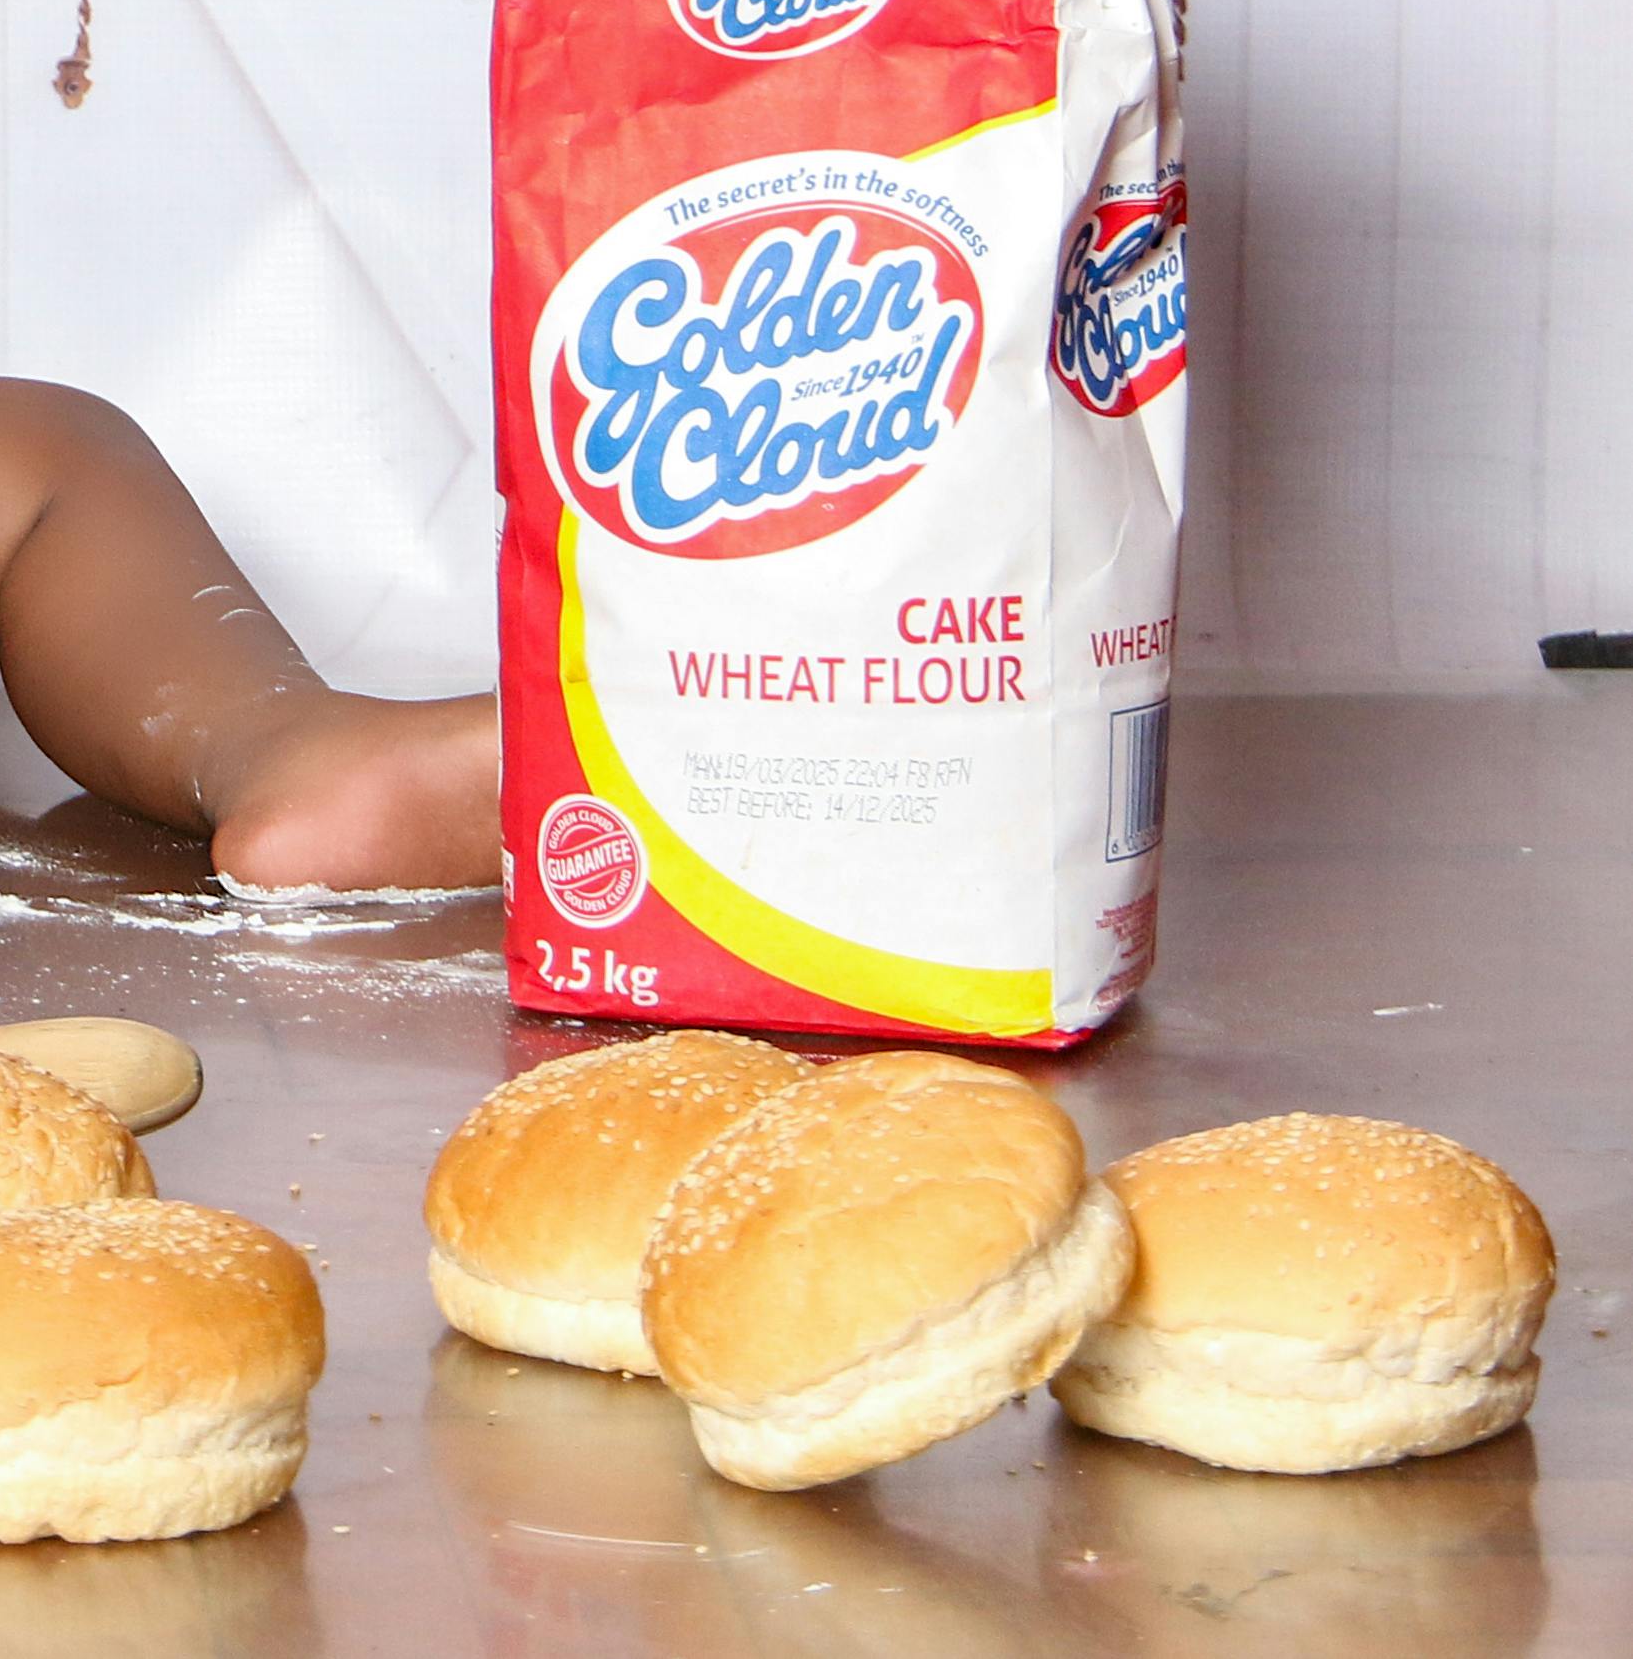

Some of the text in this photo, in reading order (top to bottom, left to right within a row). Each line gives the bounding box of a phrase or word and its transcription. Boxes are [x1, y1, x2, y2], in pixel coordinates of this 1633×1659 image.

[663, 167, 989, 258] The secret's in the softness
[579, 229, 924, 474] Golden
[791, 374, 845, 402] Since
[839, 346, 923, 397] 1940
[632, 315, 961, 529] Cloud
[897, 595, 1025, 645] CAKE
[1091, 619, 1169, 667] WHEAT
[668, 650, 1026, 704] WHEAT FLOUR
[844, 758, 898, 788] 22:04
[548, 809, 614, 850] GOLDEN CLOUD
[687, 786, 938, 824] BEST BEFORE: 14/12/2025
[547, 838, 633, 881] GUARANTEE
[563, 869, 632, 912] GOLDEN CLOUD
[536, 939, 660, 1007] 2,5 kg
